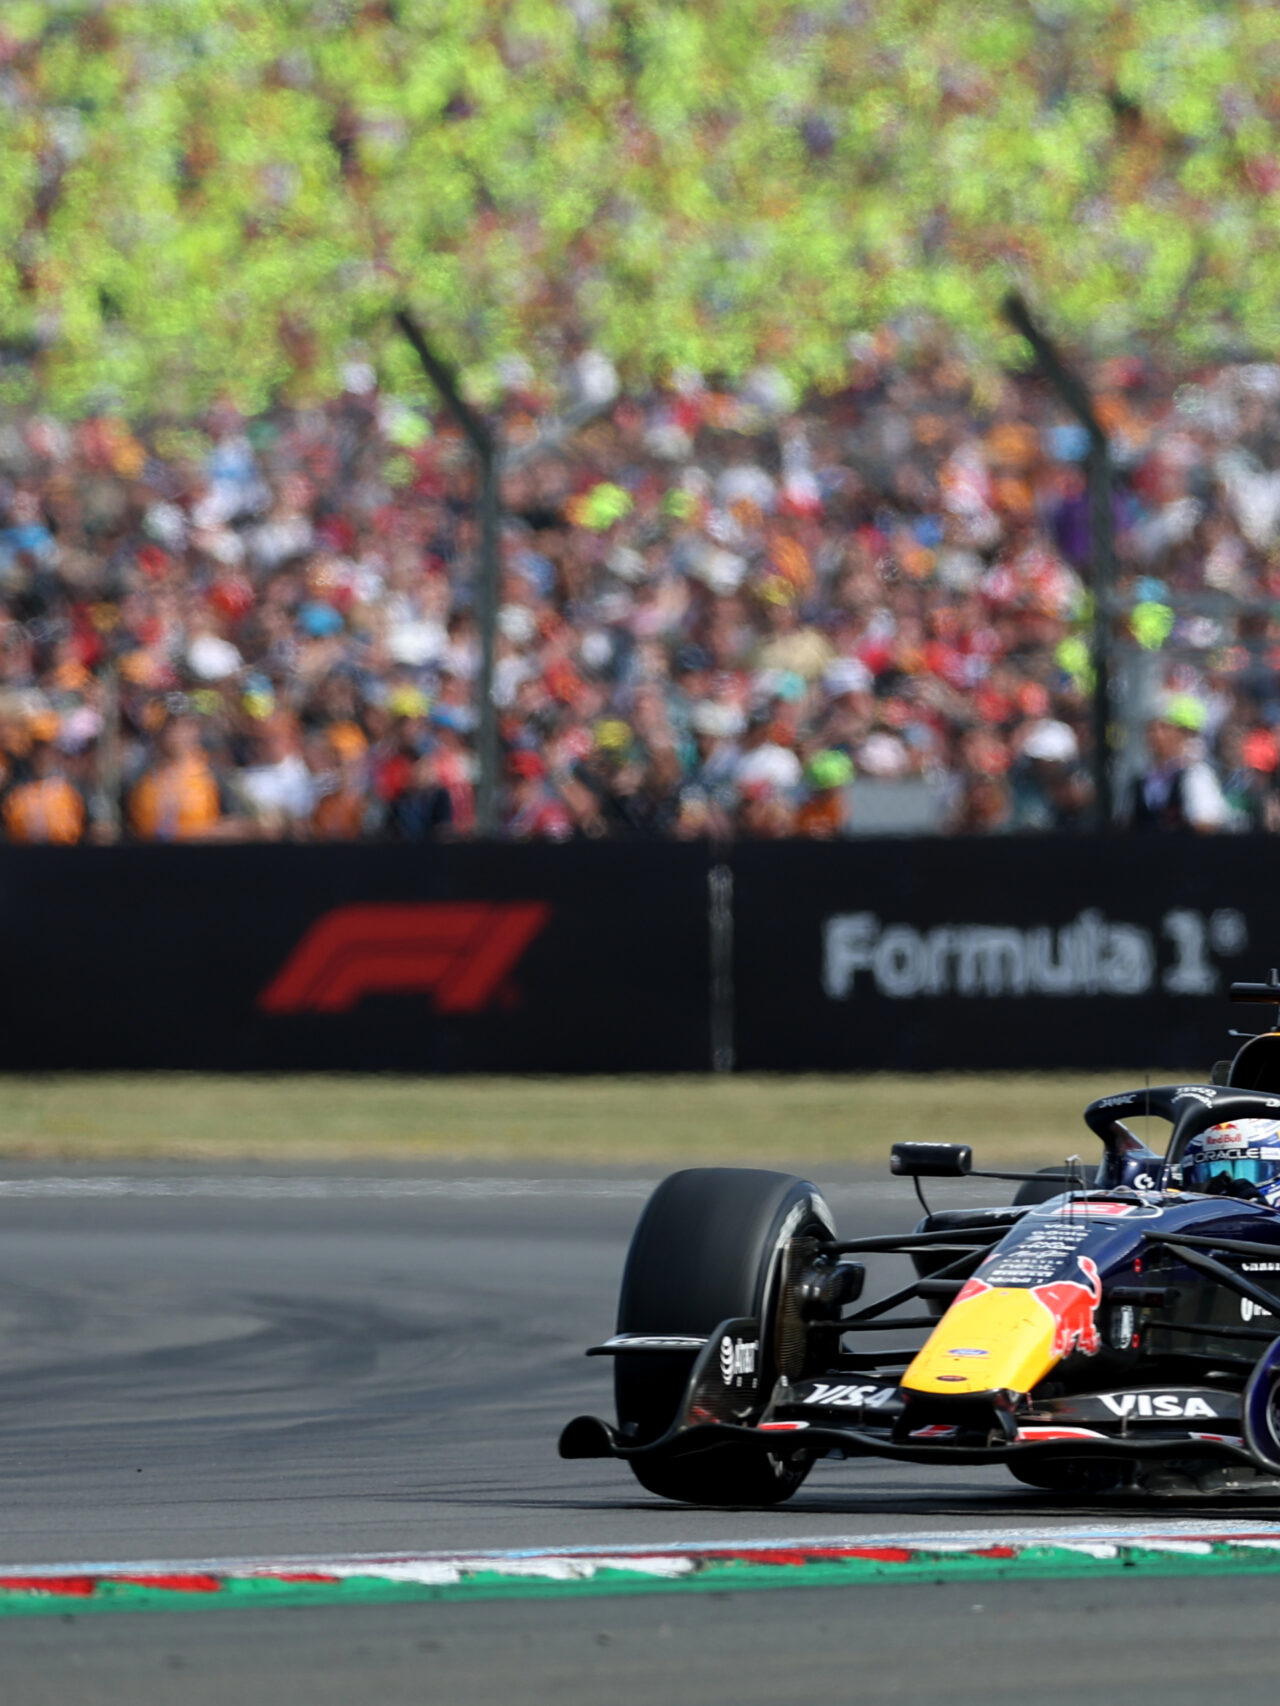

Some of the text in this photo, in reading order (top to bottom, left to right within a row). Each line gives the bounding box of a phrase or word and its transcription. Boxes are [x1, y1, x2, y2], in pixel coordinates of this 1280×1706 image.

[260, 902, 549, 1013] F1
[824, 911, 1154, 998] Formula
[1206, 1134, 1242, 1144] Red Bull
[1194, 1147, 1260, 1163] ORACLE
[803, 1383, 897, 1408] VISA
[1099, 1394, 1218, 1418] VISA
